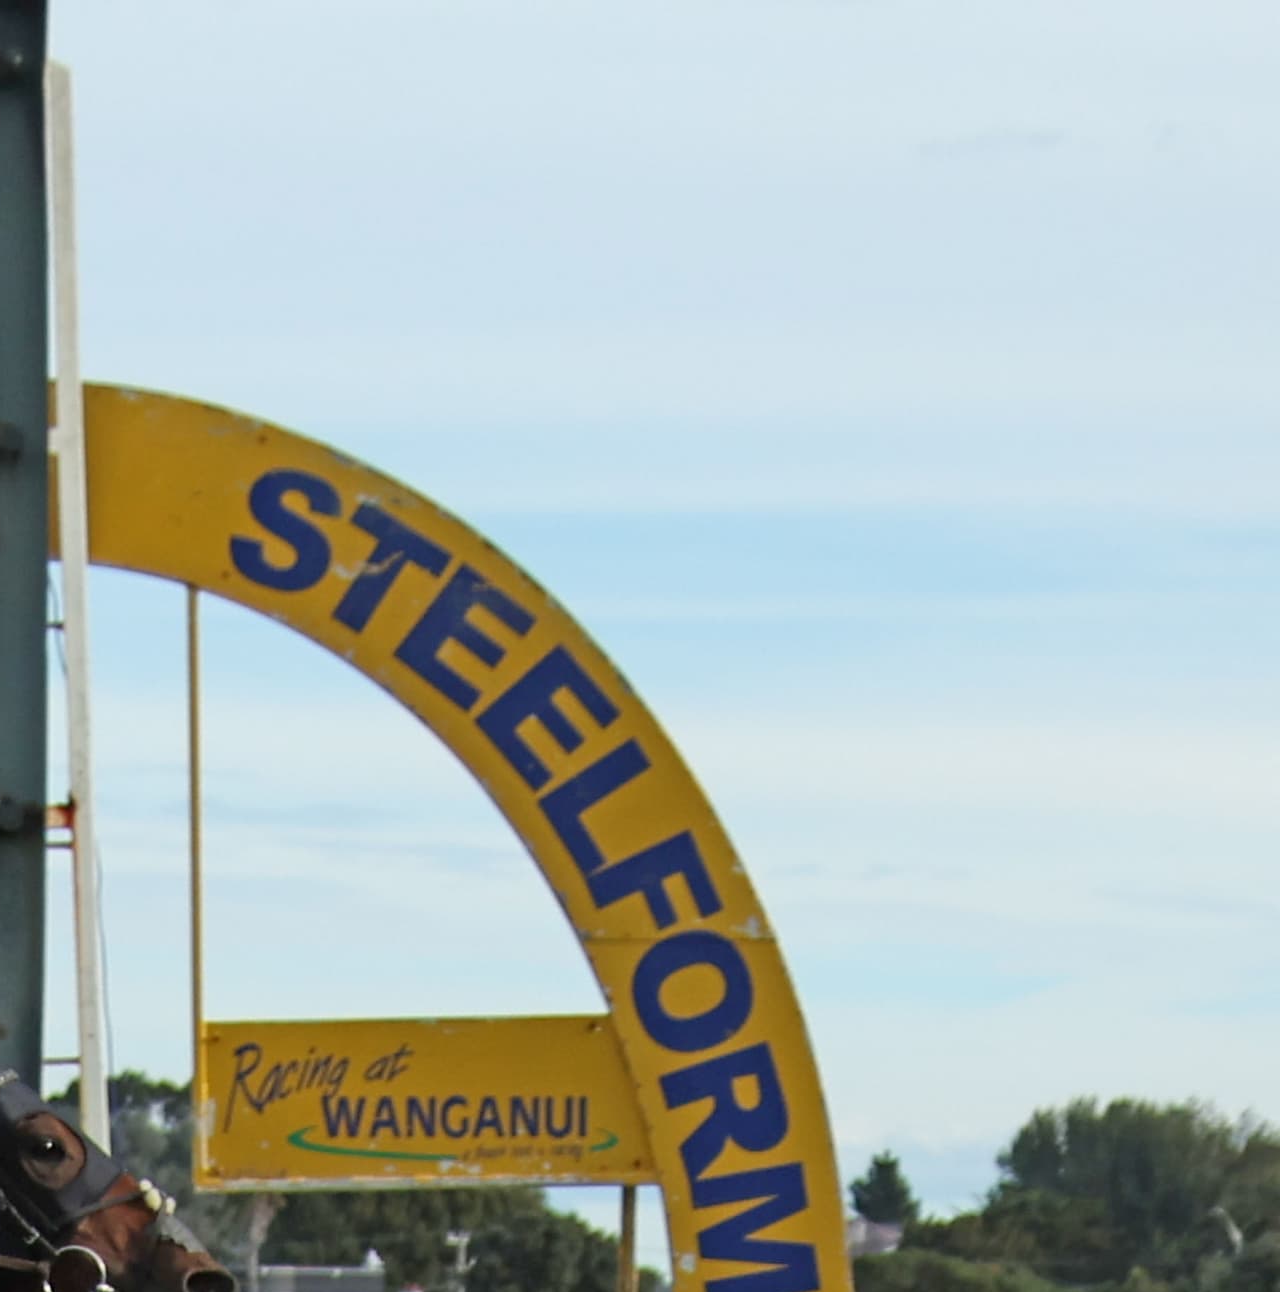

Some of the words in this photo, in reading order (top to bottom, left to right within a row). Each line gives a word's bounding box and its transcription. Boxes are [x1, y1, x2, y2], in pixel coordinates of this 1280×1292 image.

[223, 1043, 350, 1133] Racing
[364, 1043, 414, 1083] at
[320, 1095, 589, 1140] WANGANUI
